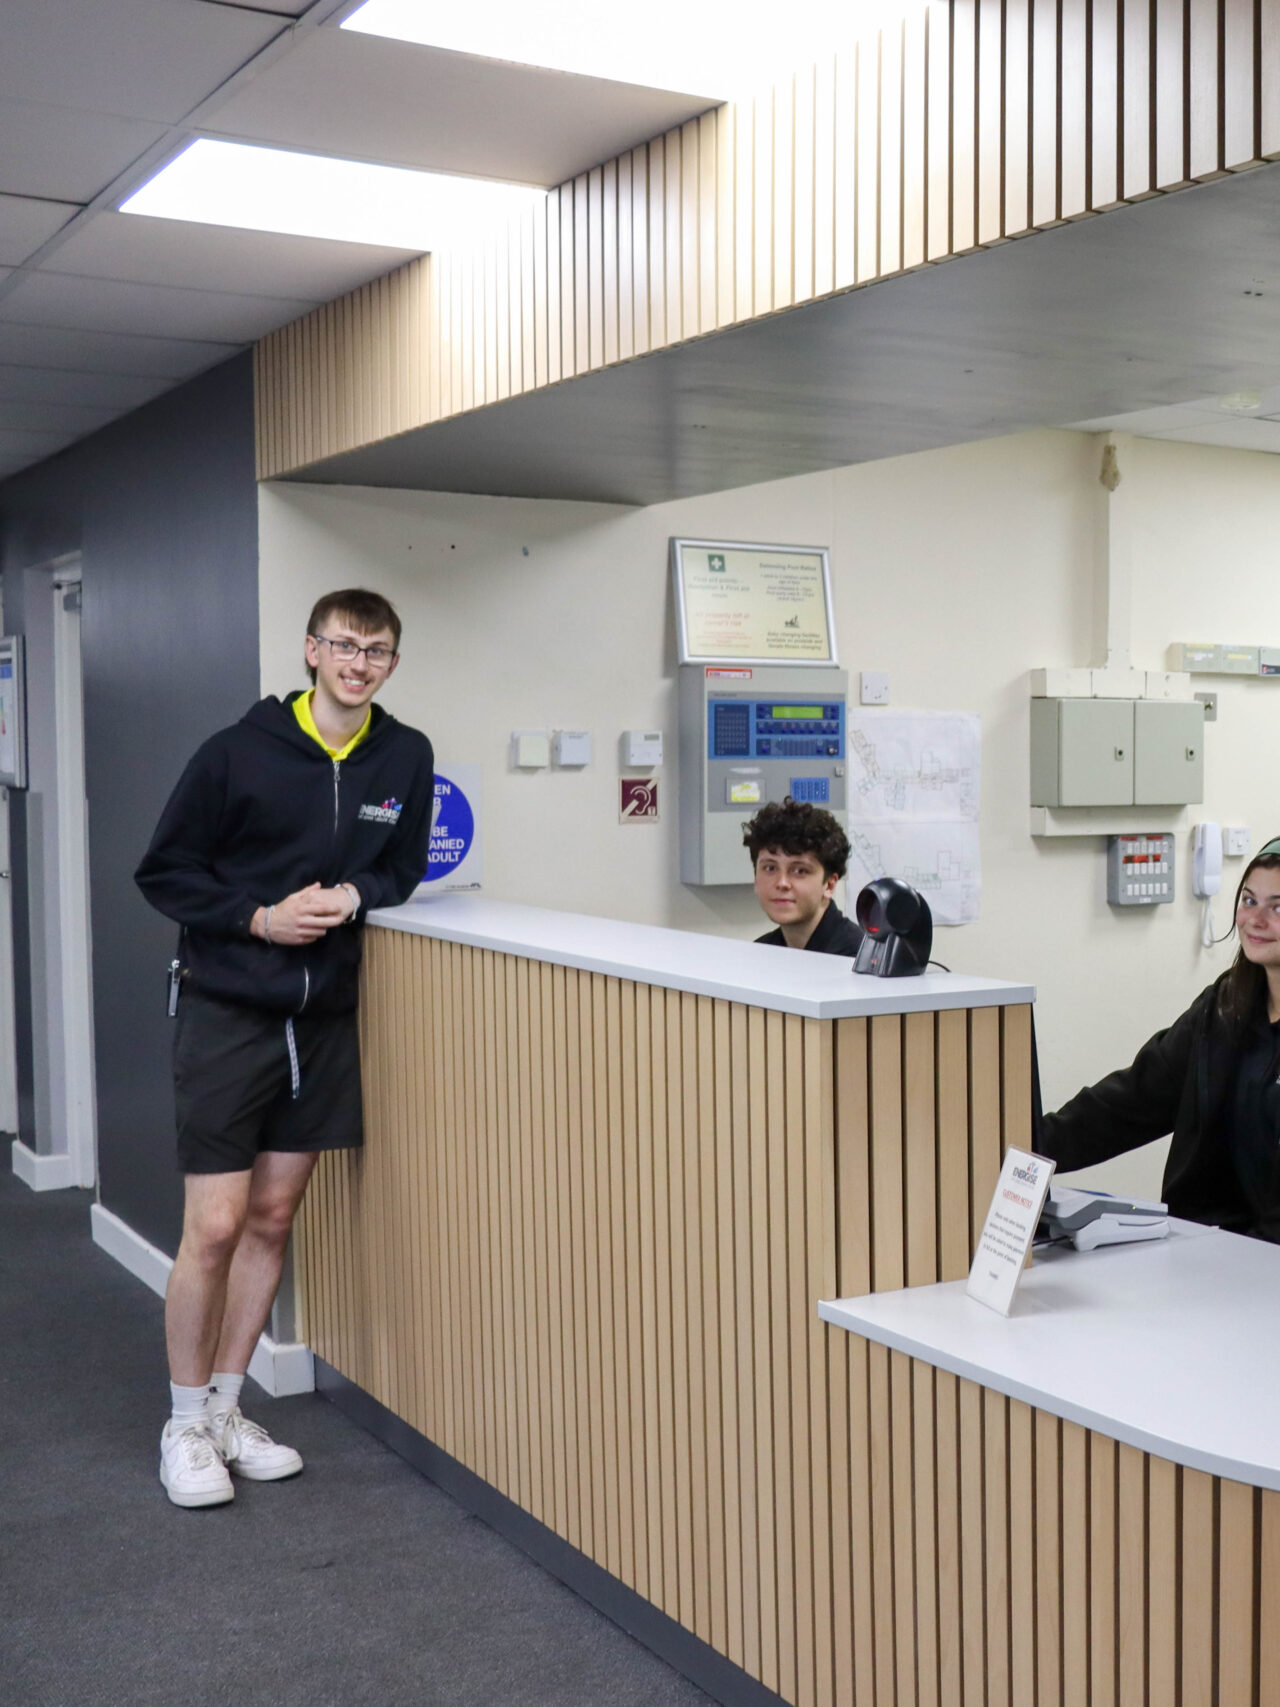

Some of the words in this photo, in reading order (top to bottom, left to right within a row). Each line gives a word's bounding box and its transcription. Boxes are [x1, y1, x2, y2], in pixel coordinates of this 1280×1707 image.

[434, 784, 451, 796] EN
[360, 803, 401, 819] NERGIS
[432, 826, 449, 837] BE
[429, 838, 465, 850] ANIED
